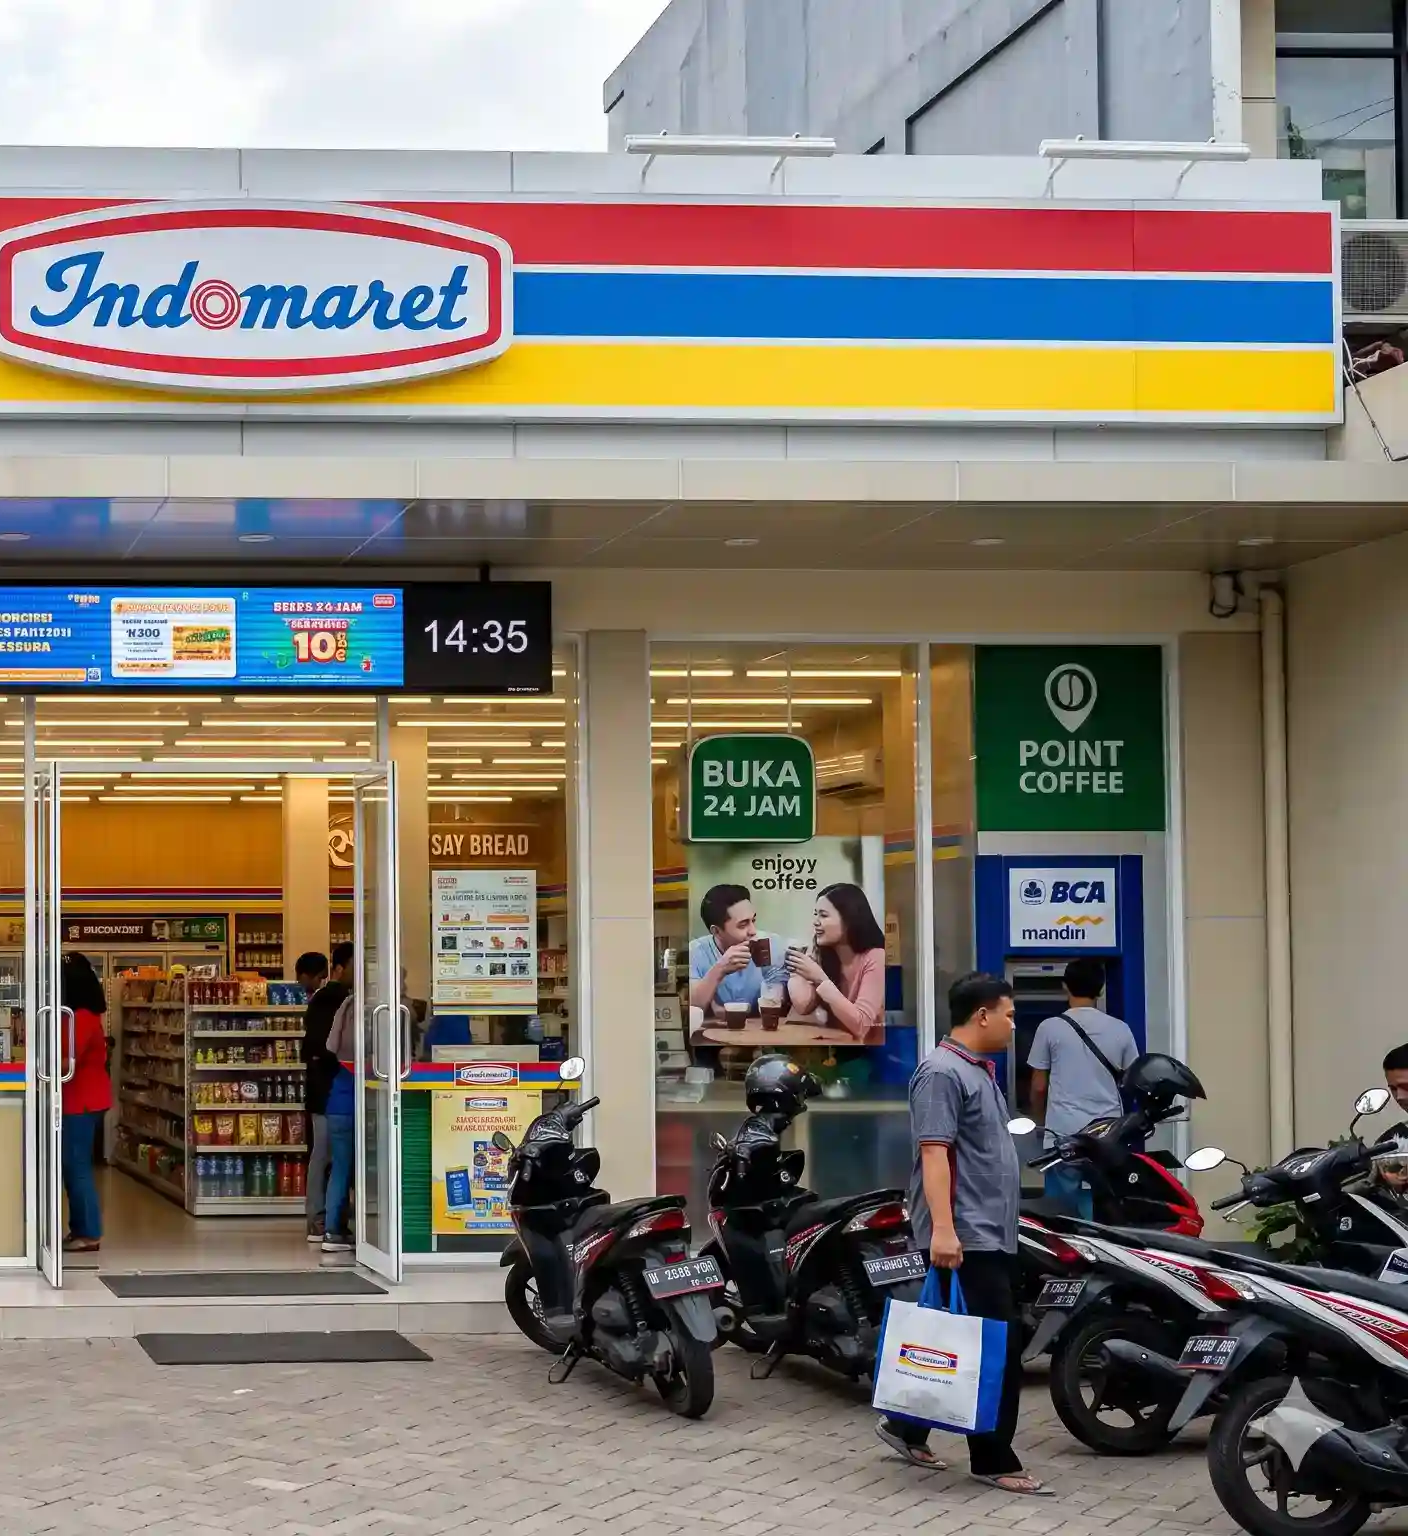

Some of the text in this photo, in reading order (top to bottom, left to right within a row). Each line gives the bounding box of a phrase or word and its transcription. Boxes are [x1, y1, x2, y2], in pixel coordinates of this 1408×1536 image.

[29, 251, 469, 331] Indomaret
[424, 620, 528, 653] 14:35
[1020, 740, 1124, 767] POINT
[702, 761, 801, 787] BUKA
[1020, 771, 1124, 794] COFFEE
[703, 795, 801, 817] 24 JAM
[431, 834, 529, 855] SAY BREAD
[751, 854, 817, 875] enjoyy
[752, 873, 817, 891] coffee
[1050, 881, 1105, 903] BCA
